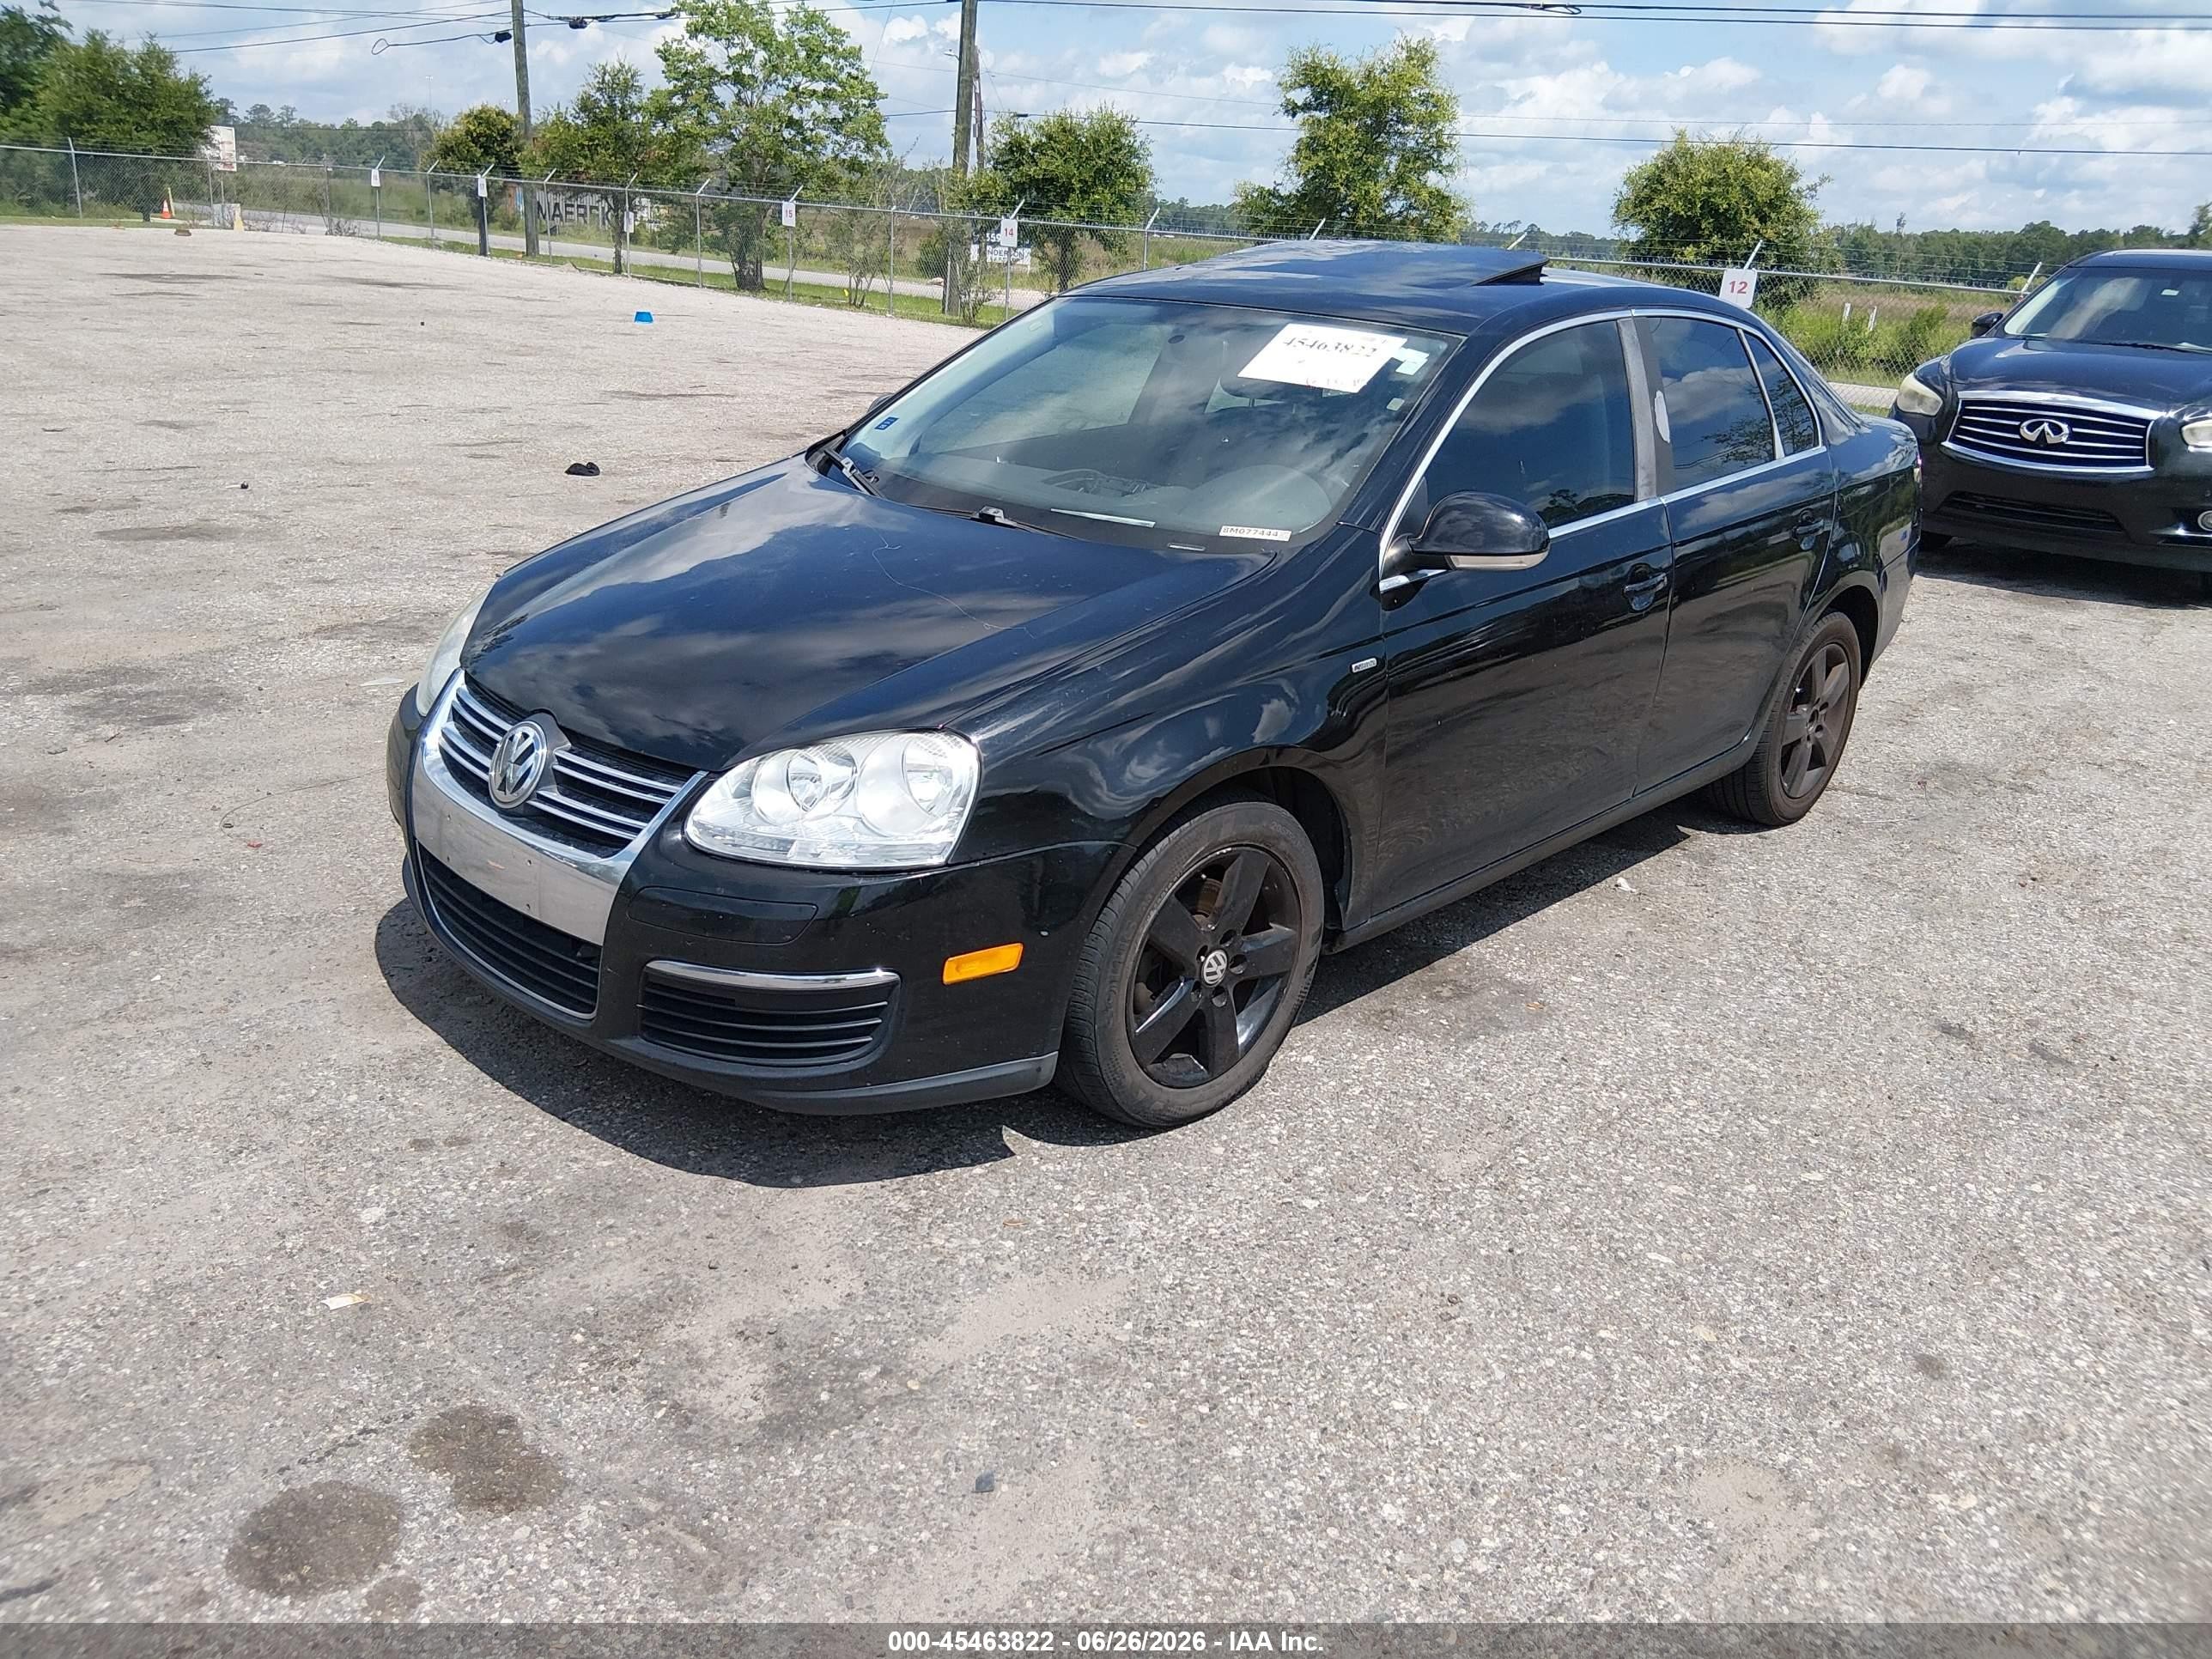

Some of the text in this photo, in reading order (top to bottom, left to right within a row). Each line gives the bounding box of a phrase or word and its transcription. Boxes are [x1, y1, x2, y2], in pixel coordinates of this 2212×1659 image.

[786, 210, 793, 218] 15
[1005, 228, 1014, 237] 14
[1729, 280, 1748, 295] 12
